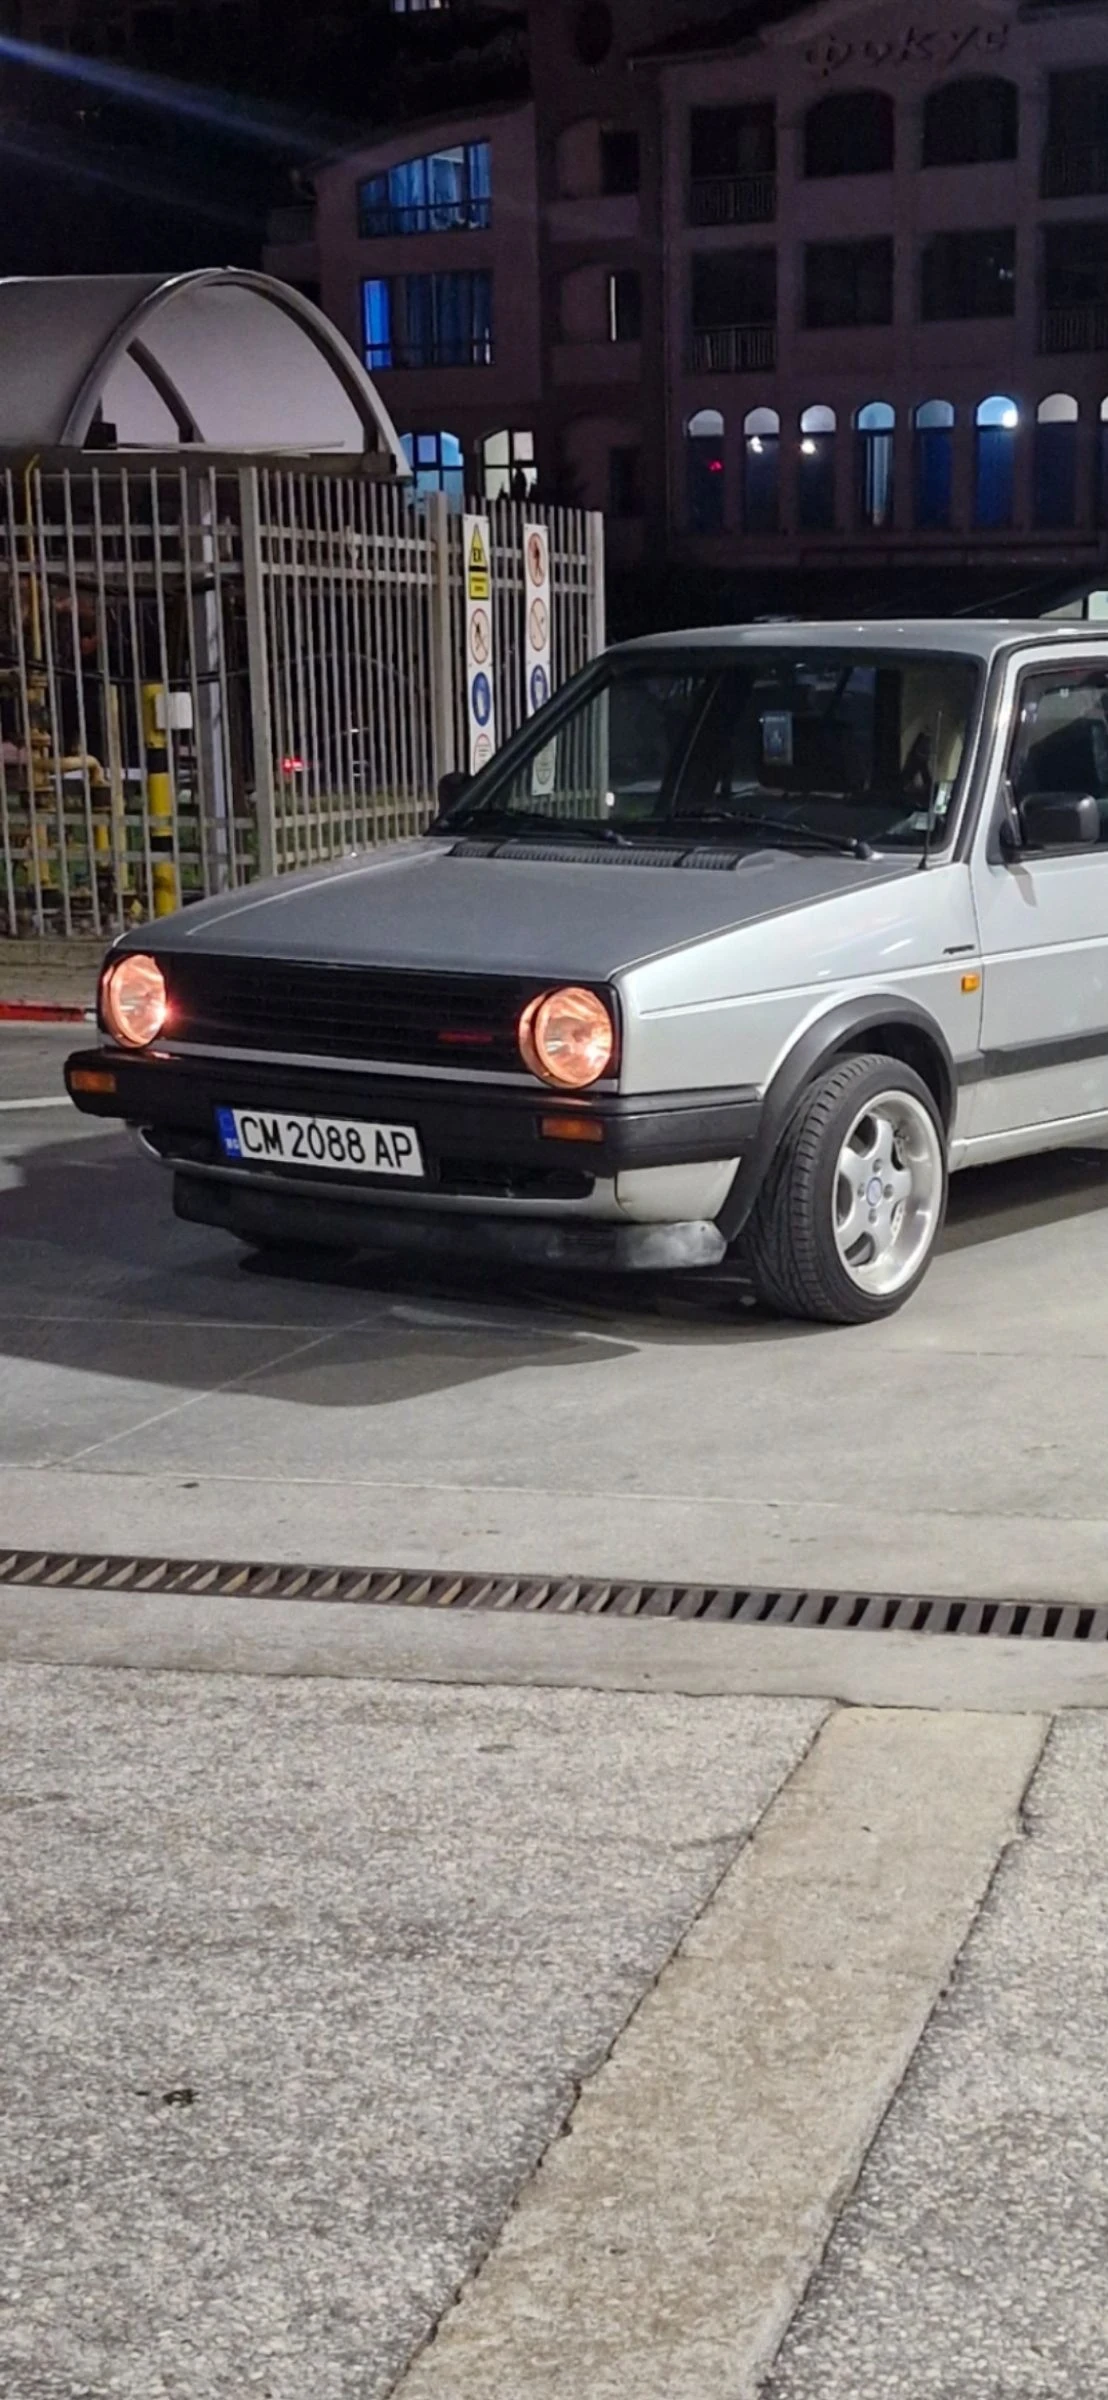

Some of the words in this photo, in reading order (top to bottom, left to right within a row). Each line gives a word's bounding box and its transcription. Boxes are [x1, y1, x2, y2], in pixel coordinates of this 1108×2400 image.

[240, 1116, 284, 1155] CM
[286, 1121, 366, 1163] 2088
[375, 1130, 413, 1168] AP
